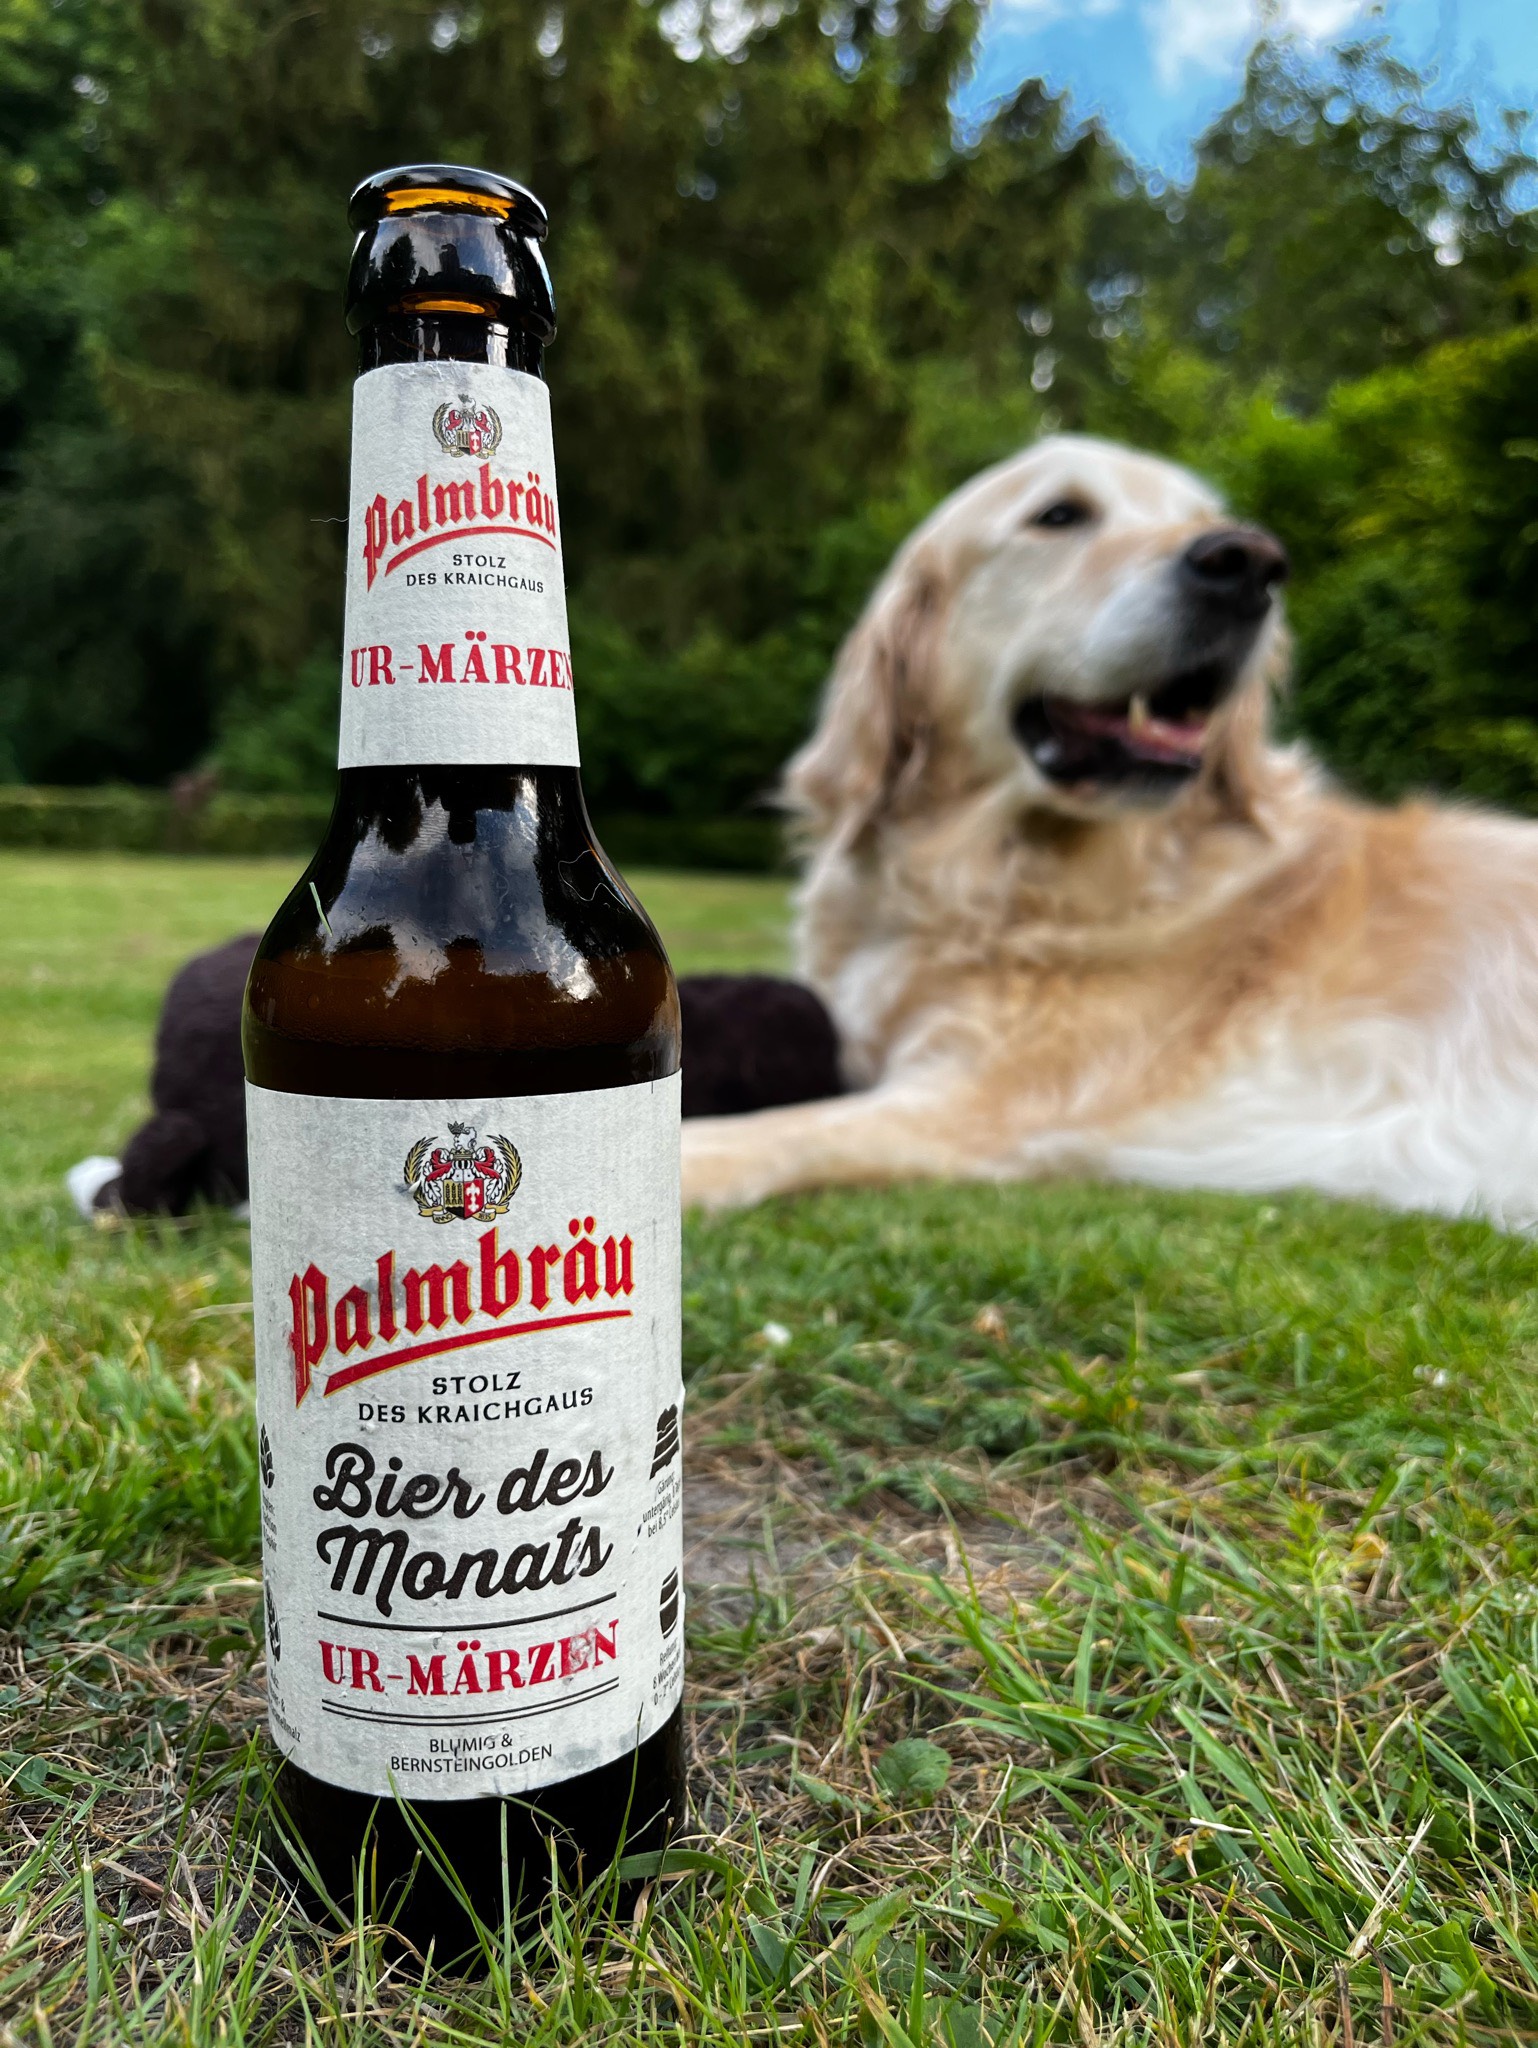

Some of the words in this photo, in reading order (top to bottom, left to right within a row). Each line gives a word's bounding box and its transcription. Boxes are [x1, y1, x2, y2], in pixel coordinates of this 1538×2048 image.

[363, 462, 558, 592] Palmbräu
[406, 573, 437, 587] DES
[443, 572, 545, 594] KRAICHGAUS
[452, 554, 507, 569] STOLZ
[350, 630, 573, 691] UR-MÄRZEN
[289, 1216, 635, 1408] Palmbräu
[358, 1403, 406, 1424] DES
[418, 1387, 594, 1424] KRAICHGAUS
[432, 1371, 522, 1396] STOLZ
[313, 1442, 486, 1519] Bier
[499, 1448, 615, 1514] des
[316, 1516, 614, 1617] Monats
[318, 1618, 620, 1696] UR-MÄRZEN
[391, 1743, 553, 1773] BERNSTEINGOLDEN
[429, 1735, 496, 1753] BLUMIG
[501, 1733, 513, 1748] &
